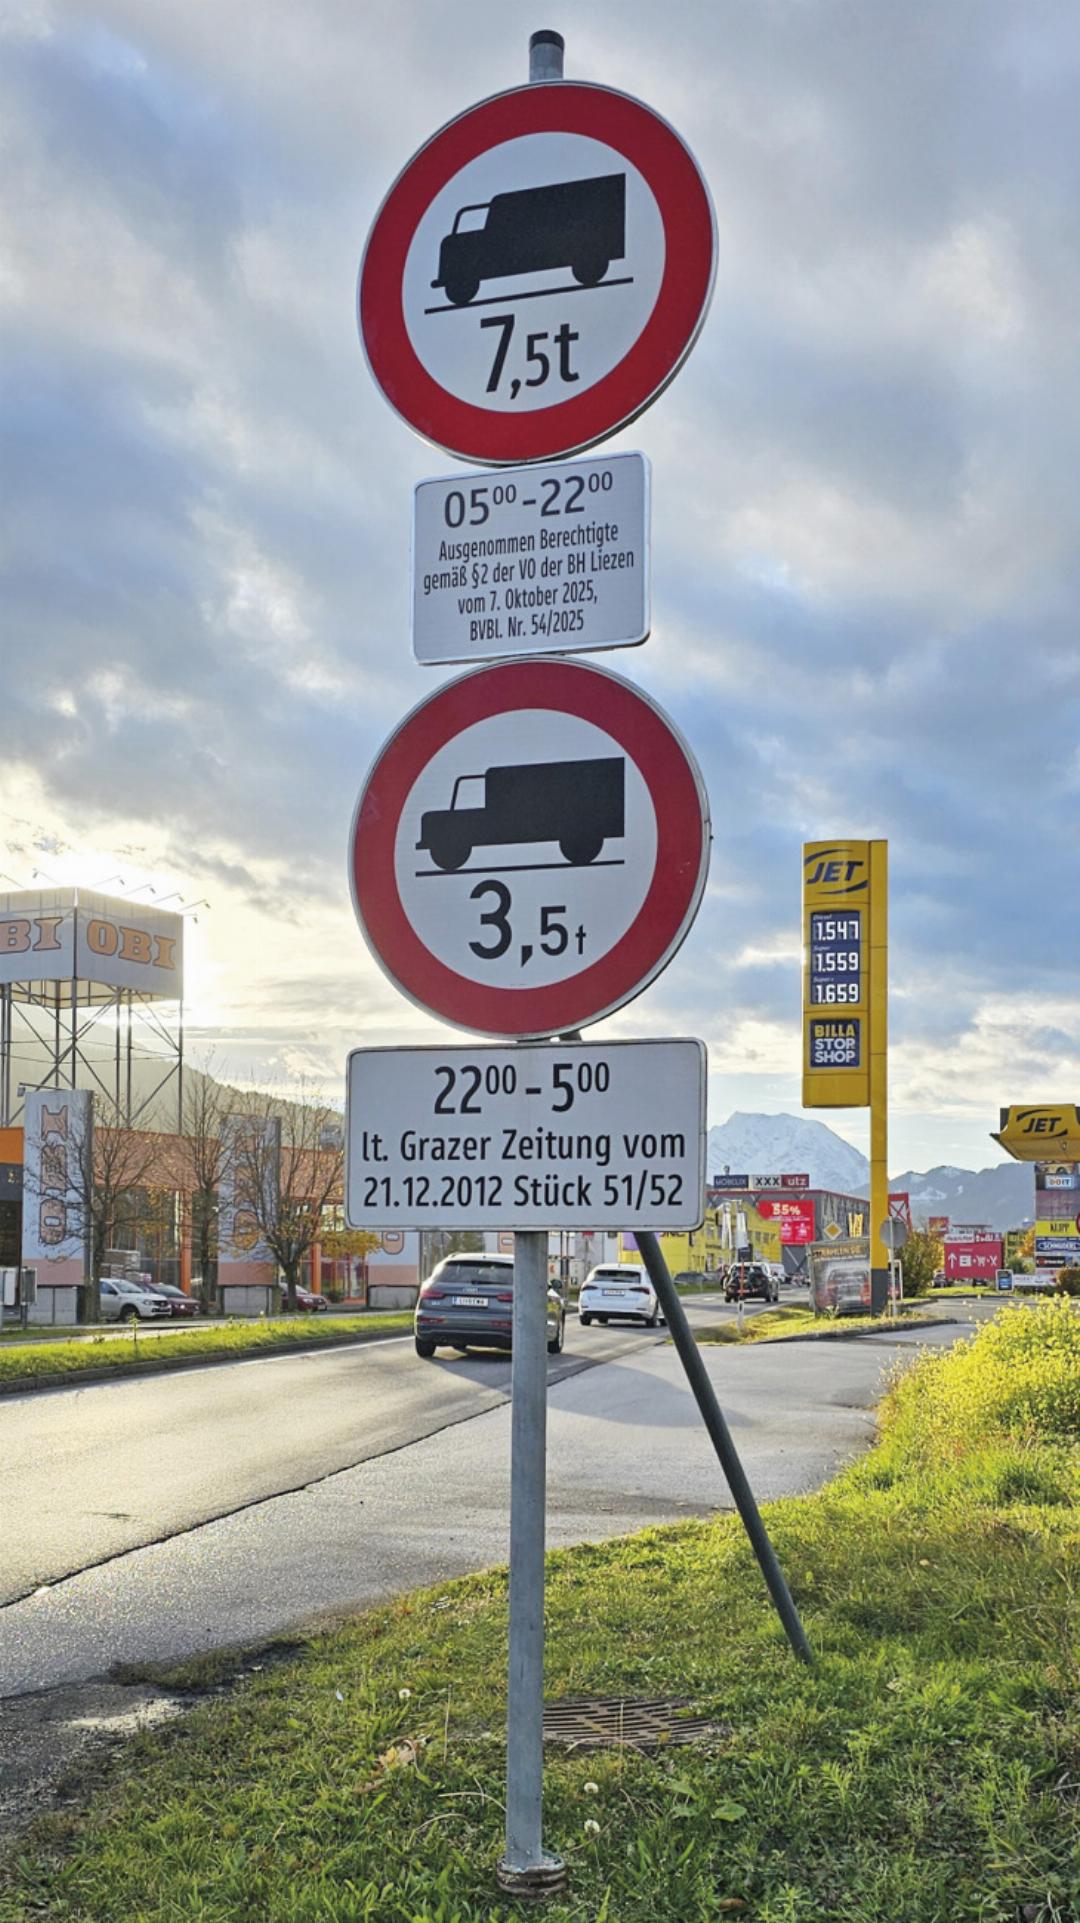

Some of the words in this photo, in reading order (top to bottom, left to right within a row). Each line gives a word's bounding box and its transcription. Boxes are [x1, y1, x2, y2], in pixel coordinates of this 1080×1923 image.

[480, 314, 579, 399] 7,5t
[439, 534, 535, 562] Ausgenommen
[540, 521, 619, 549] Berechtigte
[423, 569, 468, 595] gemäß
[471, 563, 489, 589] §2
[493, 564, 516, 583] der
[541, 556, 563, 577] der
[567, 552, 586, 574] BH
[591, 549, 635, 572] Liezen
[458, 596, 486, 615] vom
[489, 590, 500, 612] 7.
[505, 585, 559, 610] Oktober
[562, 579, 598, 604] 2025,
[508, 615, 526, 637] Nr.
[531, 609, 584, 636] 54/2025
[806, 860, 864, 885] JET
[0, 917, 64, 954] BI
[87, 919, 177, 970] OBI
[816, 921, 859, 941] 1.547
[816, 952, 859, 972] 1.559
[816, 983, 859, 1003] 1.659
[814, 1024, 856, 1038] BILLA
[814, 1050, 856, 1063] SHOP
[1022, 1117, 1061, 1133] JET
[362, 1131, 389, 1162] lt.
[400, 1130, 492, 1161] Grazer
[502, 1127, 611, 1166] Zeitung
[623, 1133, 685, 1159] vom
[363, 1176, 502, 1207] 21.12.2012
[513, 1173, 592, 1207] Stück
[603, 1170, 683, 1210] 51/52
